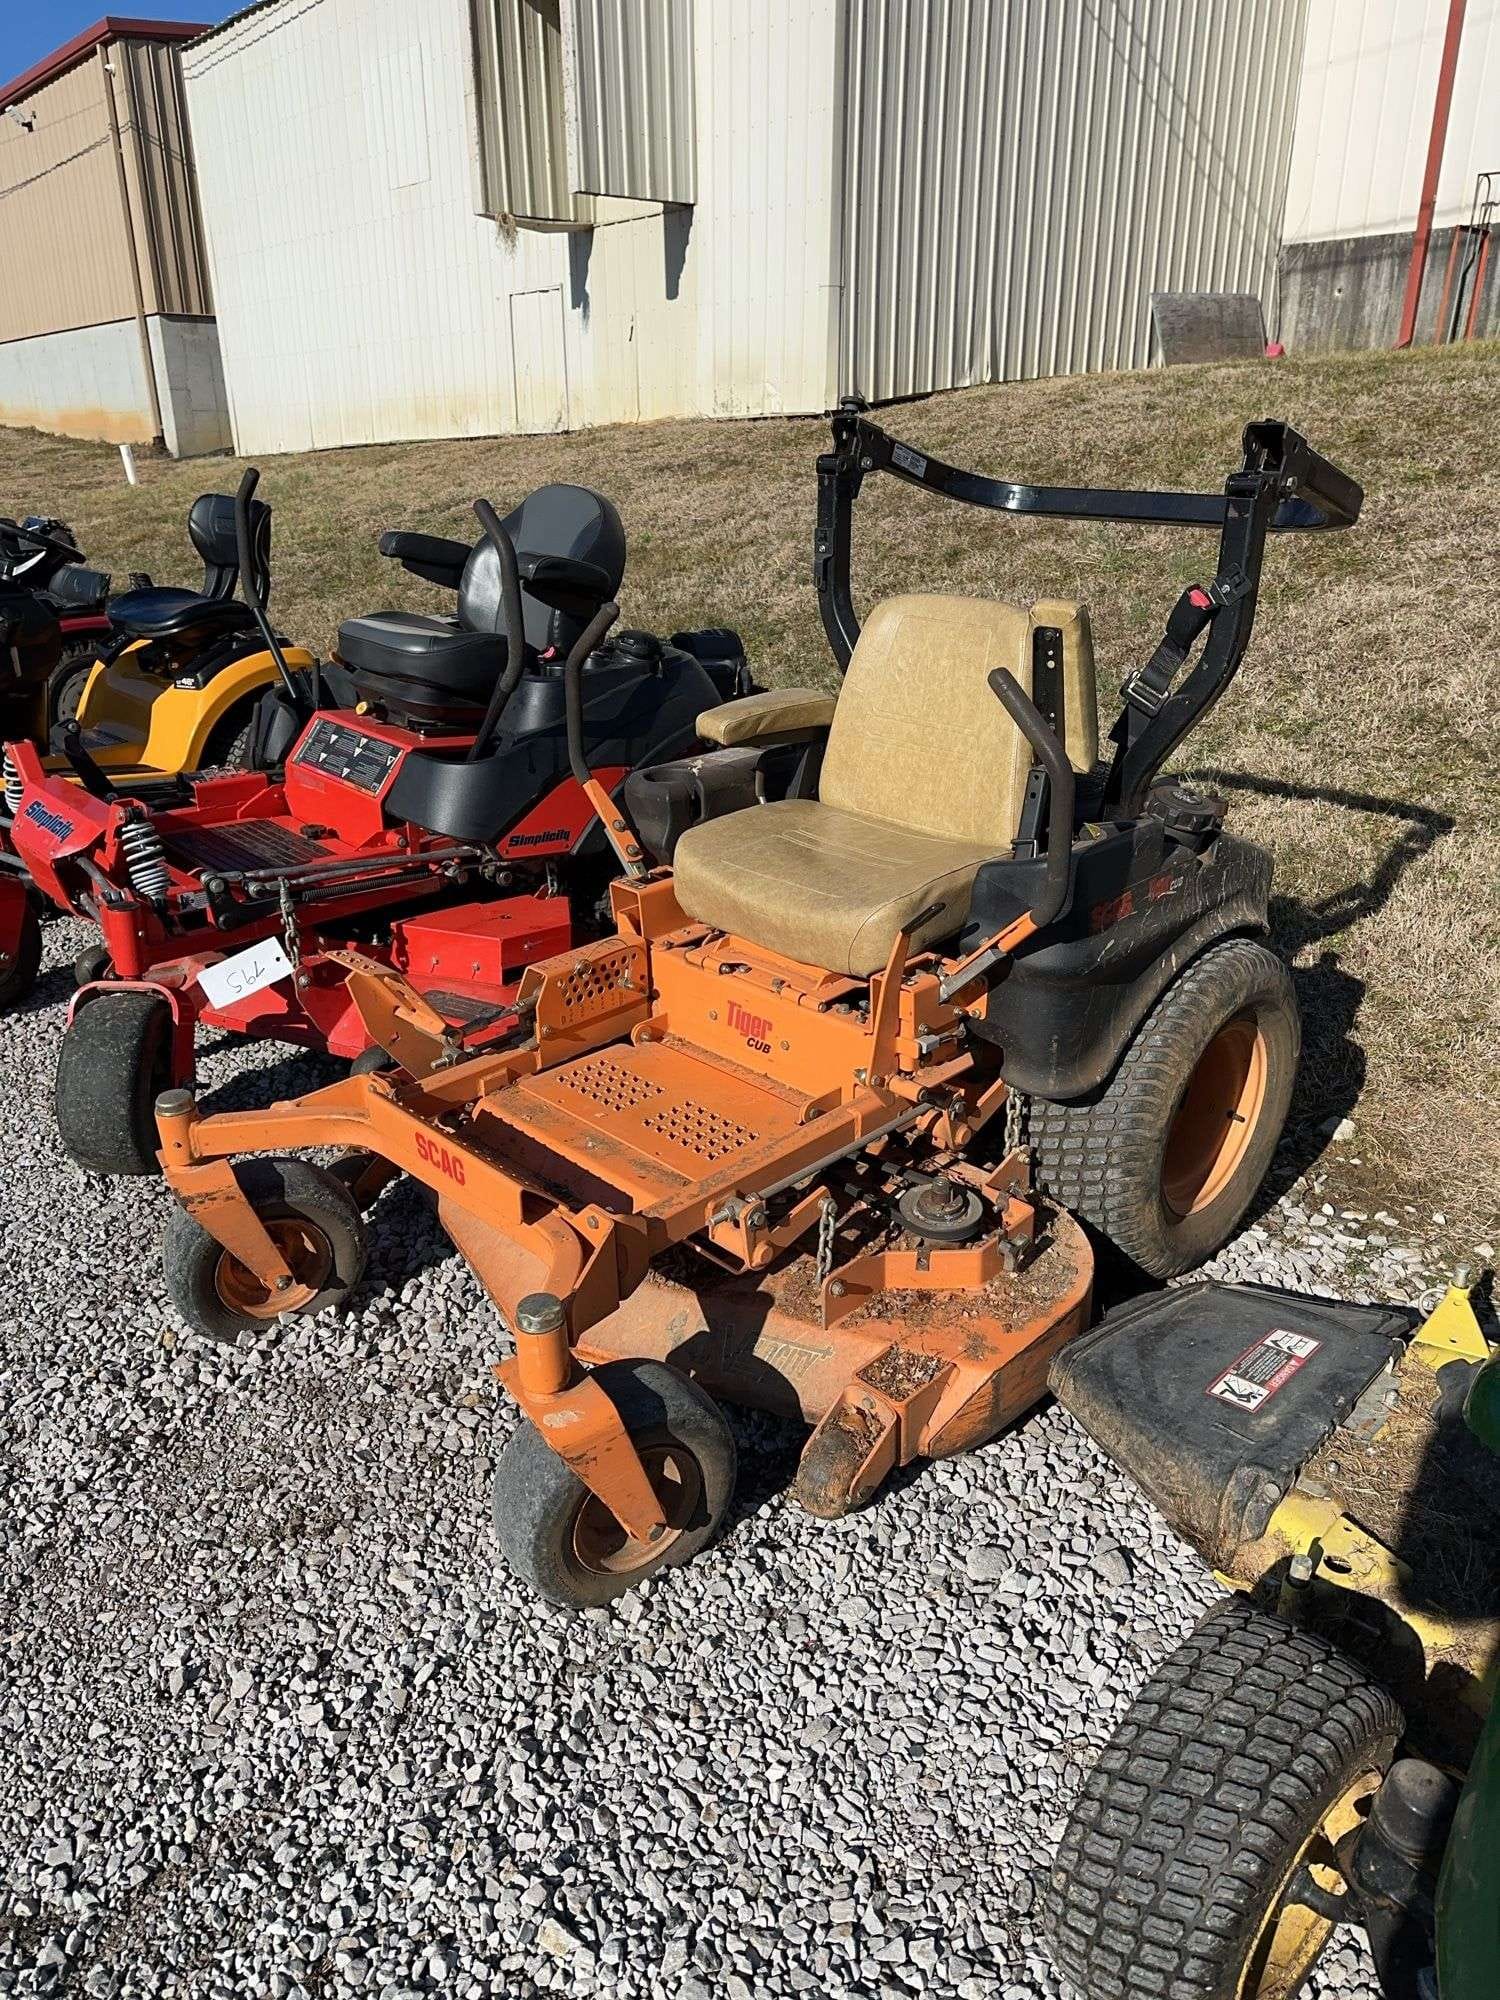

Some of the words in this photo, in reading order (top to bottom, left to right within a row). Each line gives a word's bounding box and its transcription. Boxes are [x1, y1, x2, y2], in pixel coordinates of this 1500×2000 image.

[24, 800, 74, 843] Simplicity
[508, 830, 571, 847] Simplicity
[226, 960, 266, 994] 795
[727, 1000, 773, 1040] Tiger
[746, 1037, 772, 1054] CUB
[414, 1131, 466, 1186] SCAG
